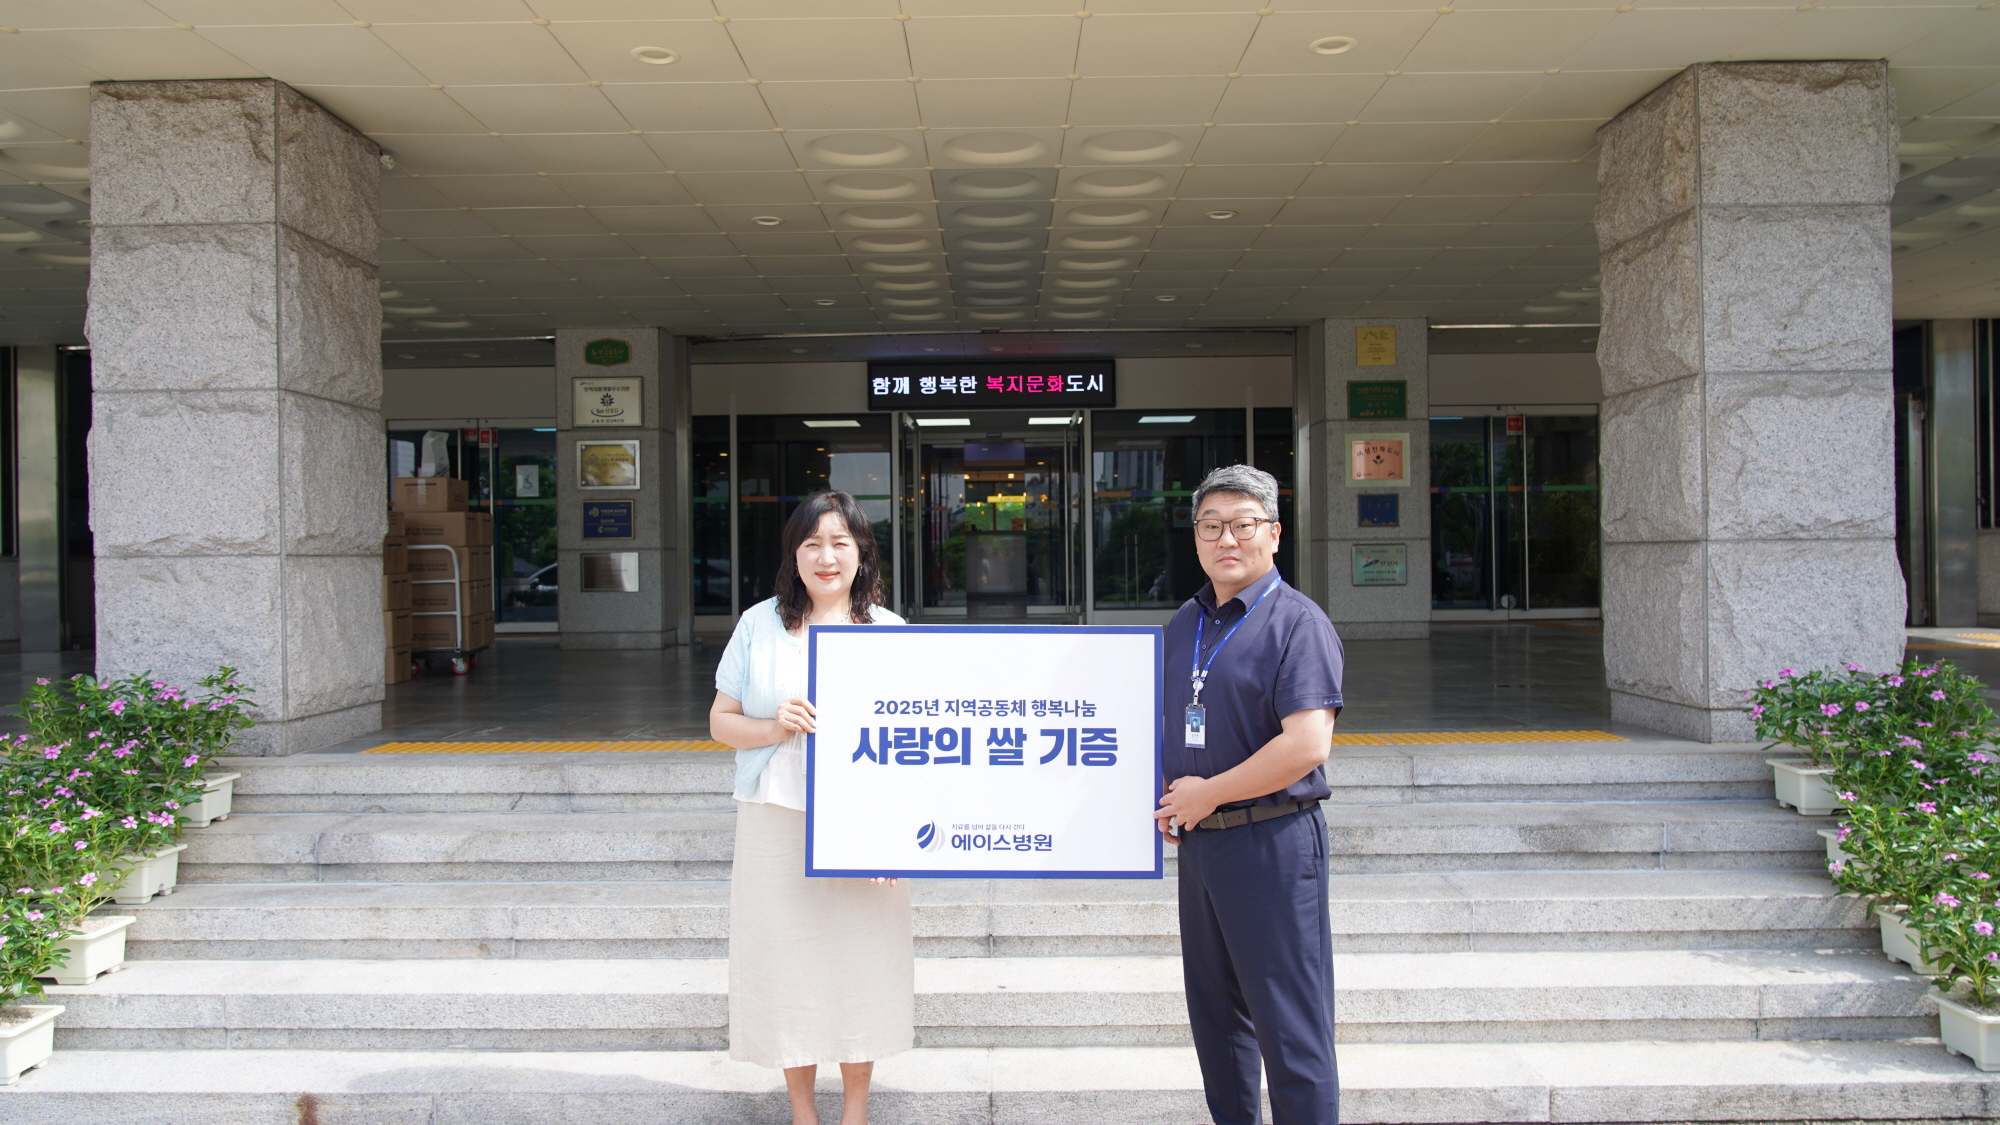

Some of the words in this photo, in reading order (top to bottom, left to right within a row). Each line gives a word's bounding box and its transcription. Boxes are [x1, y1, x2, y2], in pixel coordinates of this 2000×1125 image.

[872, 376, 910, 396] 함께
[919, 375, 978, 395] 행복한
[986, 373, 1104, 394] 복지문화도시
[874, 699, 940, 717] 2025년
[945, 699, 1026, 718] 지역공동체
[1031, 699, 1098, 718] 행복나눔
[852, 727, 972, 766] 사랑의
[986, 727, 1028, 766] 쌀
[1039, 728, 1119, 767] 기증
[951, 833, 1053, 852] 에이스병원
